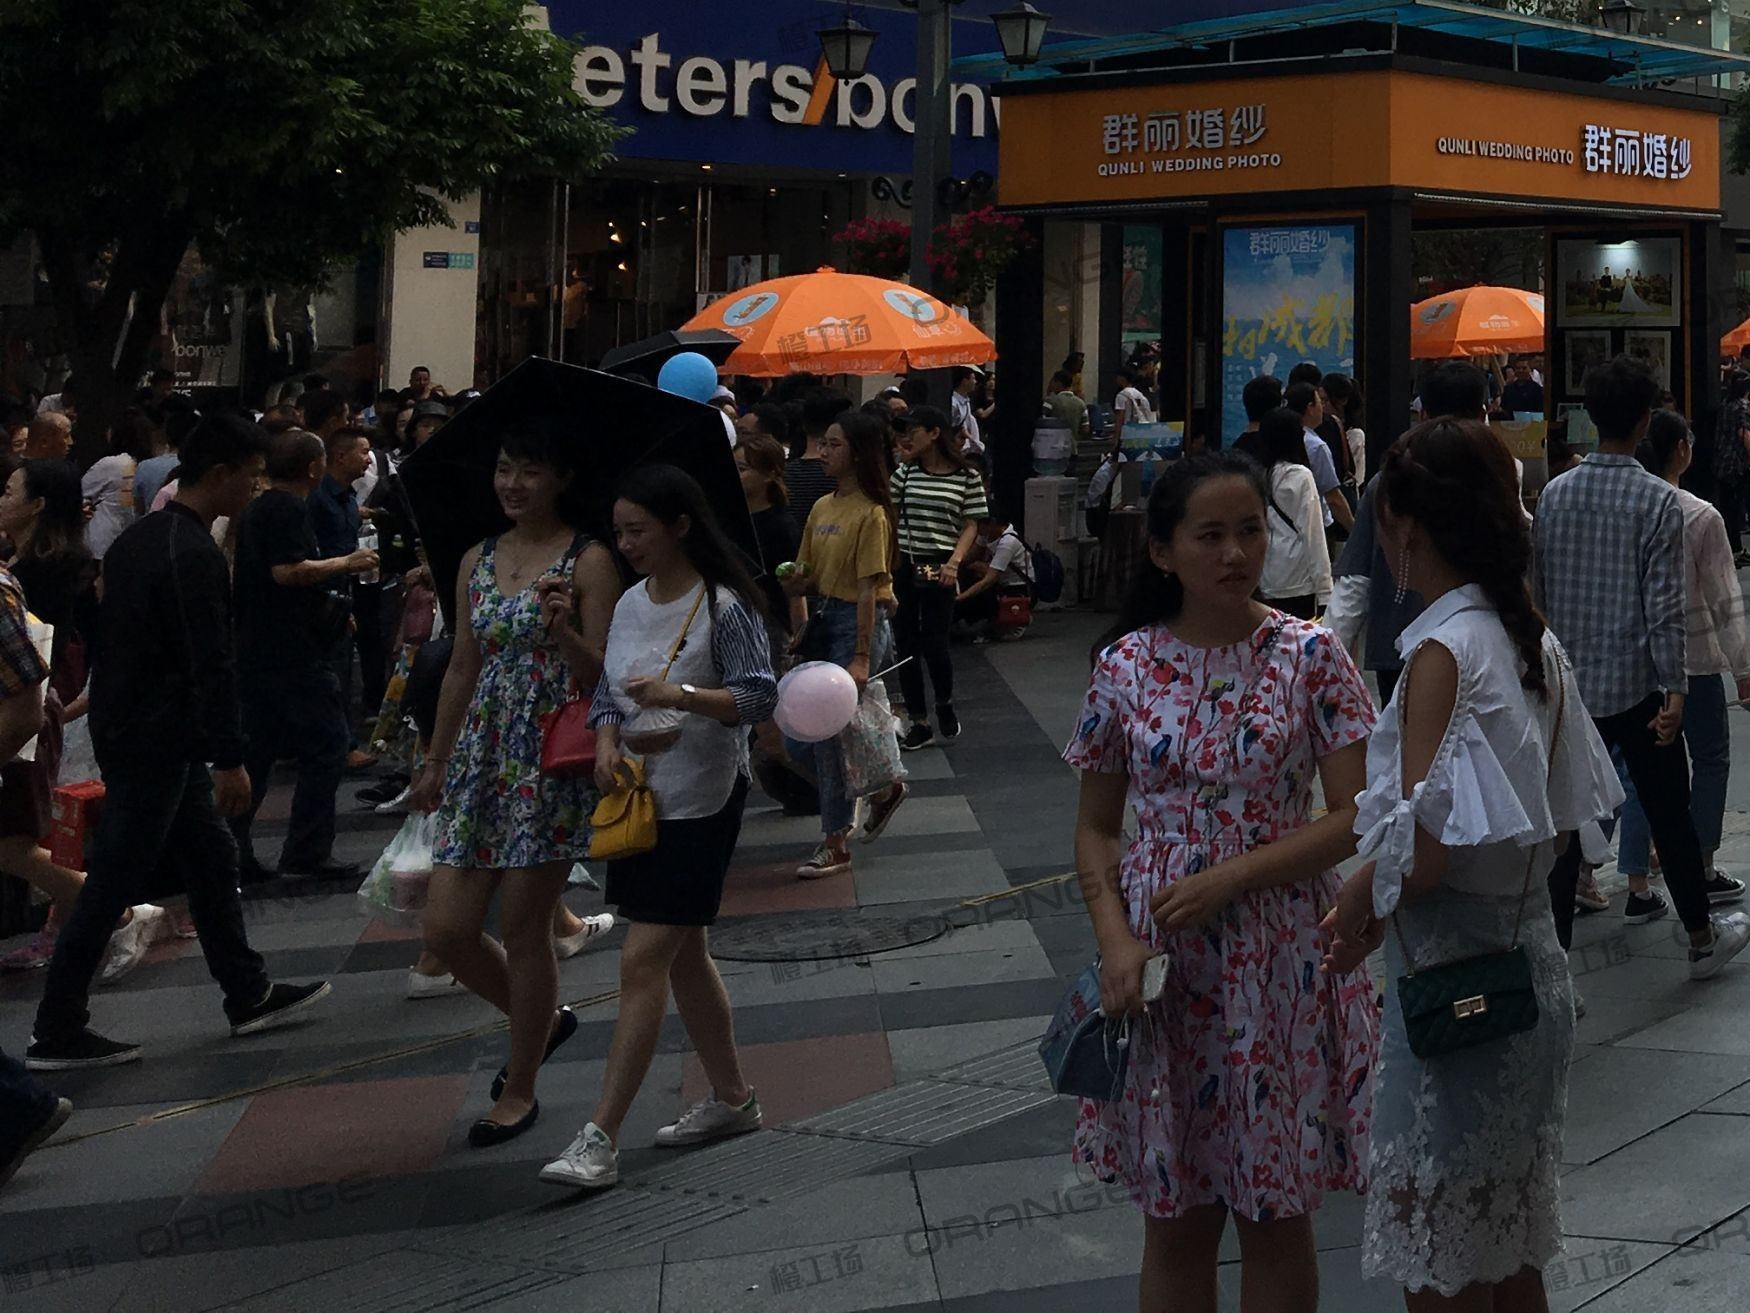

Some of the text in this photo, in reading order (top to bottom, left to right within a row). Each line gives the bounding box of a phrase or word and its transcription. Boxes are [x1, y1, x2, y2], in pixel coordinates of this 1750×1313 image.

[1102, 103, 1268, 155] 群丽婚纱
[1097, 152, 1281, 177] QUNLI WEDDING PHOTO
[1437, 136, 1574, 165] QUNLI WEDDING PHOTO
[1584, 124, 1692, 181] 群丽婚纱
[1249, 230, 1331, 256] 群丽婚纱
